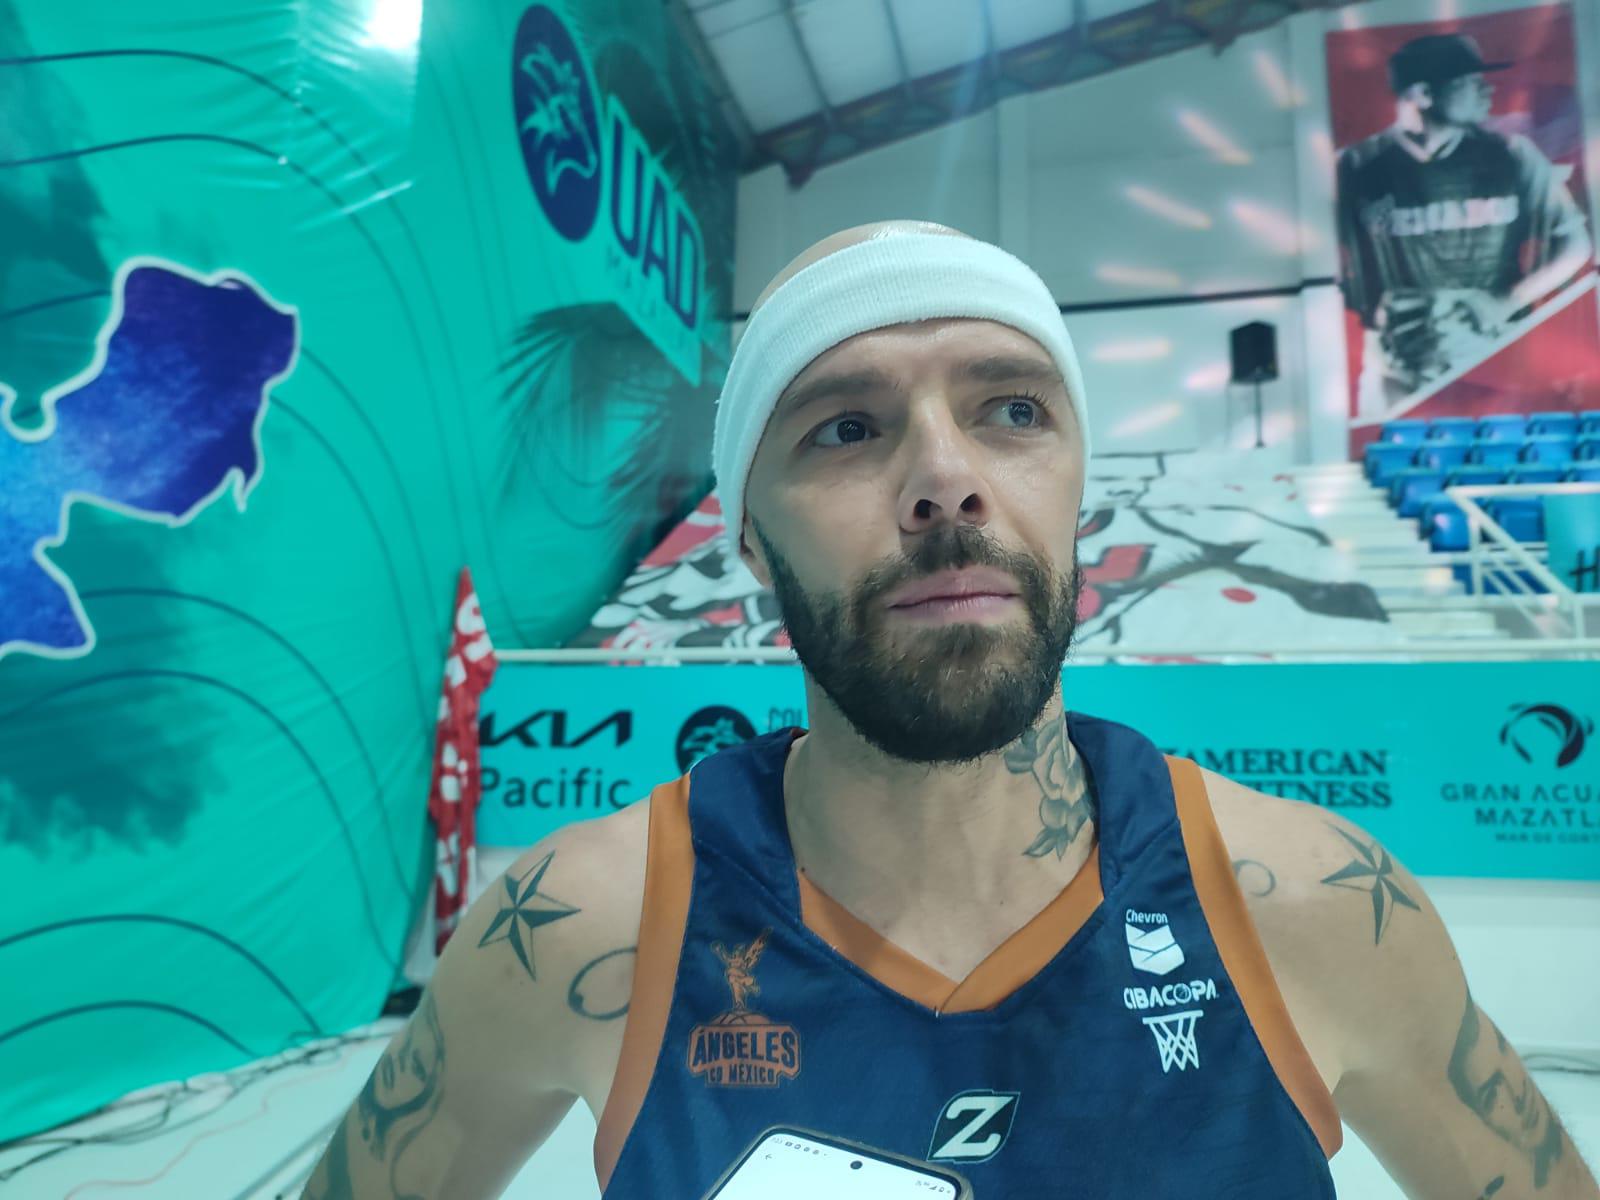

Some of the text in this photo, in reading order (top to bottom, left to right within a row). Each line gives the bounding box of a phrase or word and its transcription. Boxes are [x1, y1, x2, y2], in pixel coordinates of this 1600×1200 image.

[610, 115, 698, 330] UAD
[479, 709, 633, 748] KIA
[479, 767, 632, 809] Pacific
[1439, 783, 1600, 803] GRAN ACU
[1474, 807, 1600, 828] MAZATL
[1125, 908, 1168, 924] Chevron
[1123, 978, 1217, 1009] CIBACOPA
